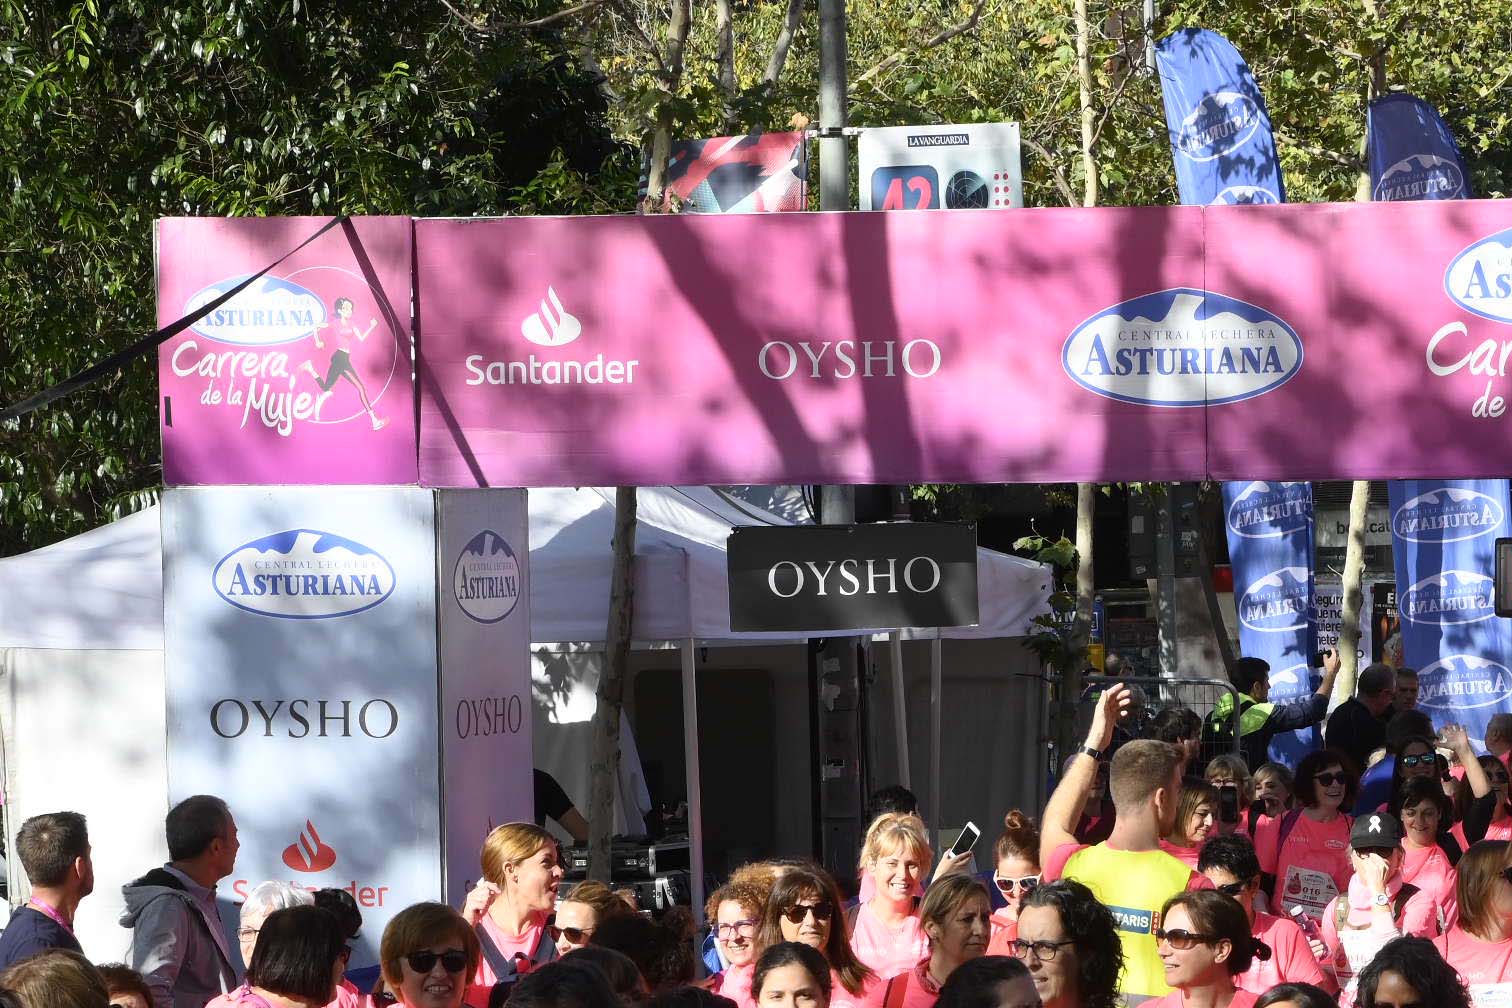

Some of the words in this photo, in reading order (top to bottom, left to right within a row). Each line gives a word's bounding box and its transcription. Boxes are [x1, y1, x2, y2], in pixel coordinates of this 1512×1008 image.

[171, 340, 289, 378] Carrera
[465, 352, 639, 386] Santander
[758, 338, 942, 381] OYSHO
[1081, 333, 1286, 378] ASTURIANA
[200, 380, 223, 406] de
[227, 377, 243, 406] la
[240, 375, 333, 437] Mujer
[1471, 381, 1505, 418] de
[227, 562, 383, 597] ASTURIANA
[459, 567, 517, 601] ASTURIANA
[768, 555, 942, 598] OYSHO
[209, 698, 399, 739] OYSHO
[456, 694, 522, 740] OYSHO
[1112, 911, 1150, 929] TARIS
